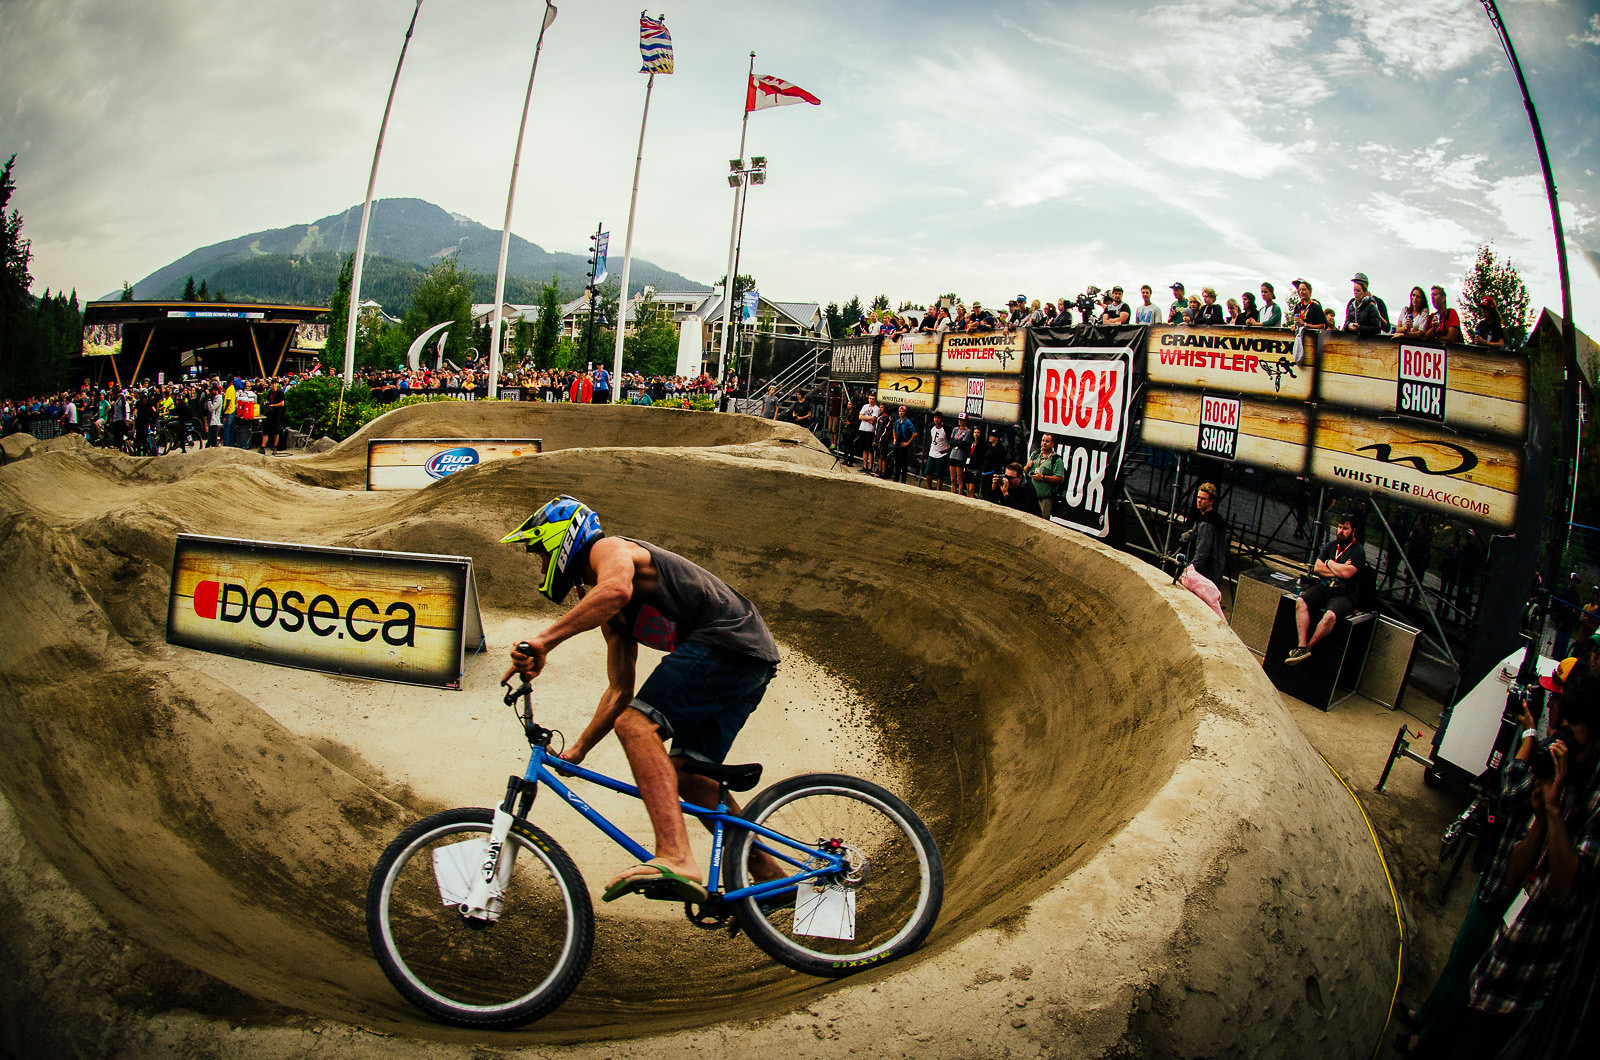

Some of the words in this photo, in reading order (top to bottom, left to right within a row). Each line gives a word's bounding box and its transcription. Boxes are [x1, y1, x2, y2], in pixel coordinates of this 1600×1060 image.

[948, 336, 1016, 347] CRANKWORX
[948, 348, 995, 360] WHISTLER
[1161, 334, 1294, 355] CRANKWORX
[1160, 349, 1259, 374] WHISTLER
[1403, 349, 1442, 380] ROCK
[1044, 368, 1117, 432] ROCK
[1401, 383, 1442, 415] SHOX
[1204, 400, 1237, 426] ROCK
[1201, 427, 1234, 455] SHOX
[433, 463, 474, 472] LIGH
[440, 454, 474, 464] BUD
[1057, 444, 1108, 514] OX
[557, 511, 586, 575] BELL
